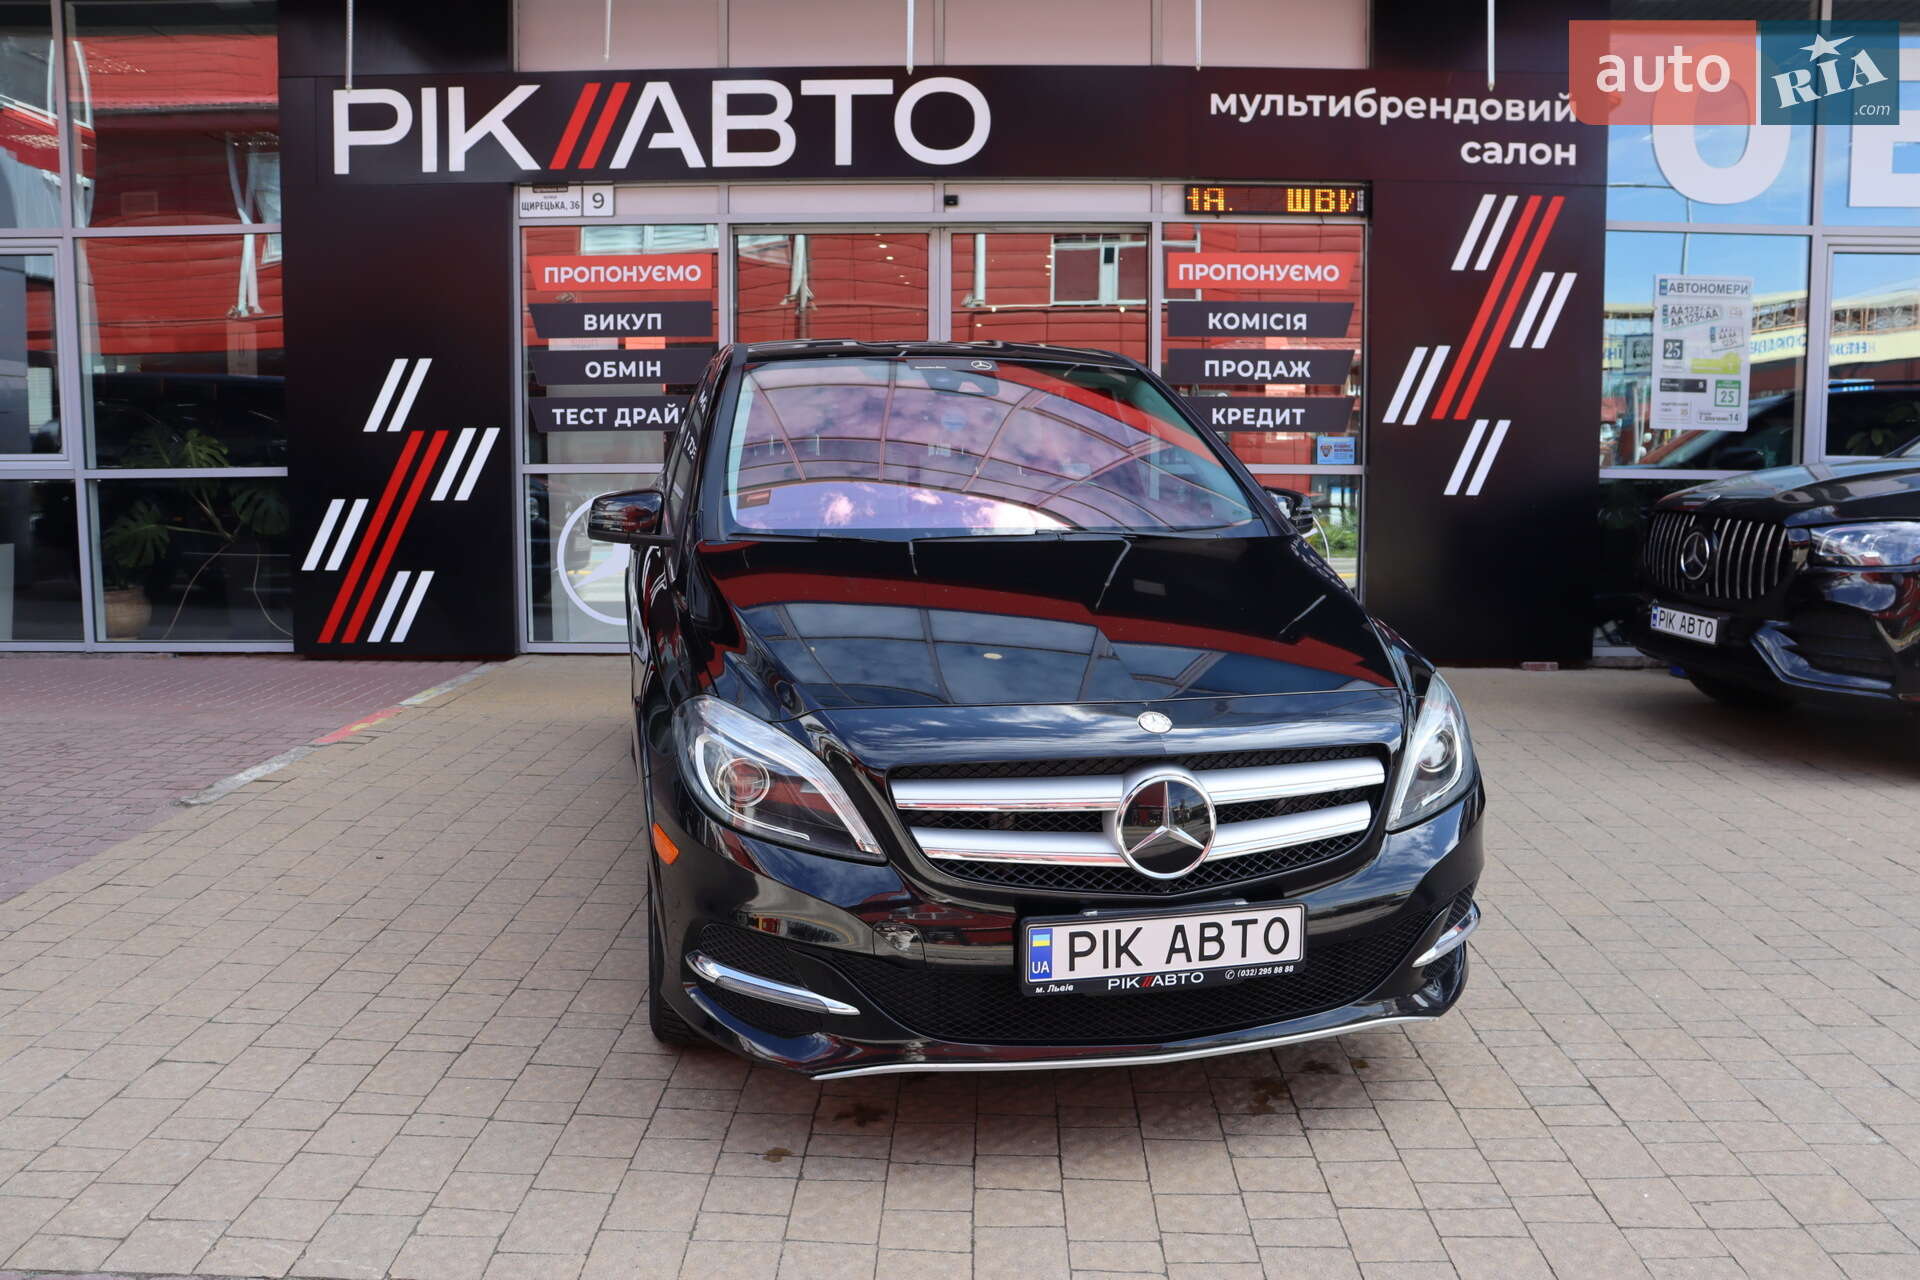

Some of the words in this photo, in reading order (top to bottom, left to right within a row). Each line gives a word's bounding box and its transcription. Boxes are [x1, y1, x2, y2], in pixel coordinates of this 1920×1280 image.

[1210, 87, 1577, 125] мультибрендовий
[1460, 141, 1577, 166] салон
[569, 200, 580, 210] 36
[592, 192, 605, 209] 9
[544, 264, 701, 284] ПРОПОНУЄМО
[1178, 263, 1340, 282] ПРОПОНУЄМО
[1668, 282, 1749, 295] АВТОНОМЕРИ
[583, 313, 662, 331] ВИКУП
[1208, 312, 1307, 330] КОМІСІЯ
[1665, 342, 1681, 358] 25
[585, 360, 662, 378] ОБМІН
[1204, 360, 1311, 380] ПРОДАЖ
[1720, 390, 1735, 403] 25
[552, 407, 607, 425] ТЕСТ
[614, 402, 685, 427] ДРАЙ
[1211, 408, 1306, 428] КРЕДИТ
[1165, 916, 1290, 965] АВТО
[1031, 960, 1050, 975] UA
[1237, 967, 1257, 978] (032)
[1258, 966, 1272, 976] 295
[1273, 966, 1283, 974] 88
[1284, 965, 1294, 973] 88
